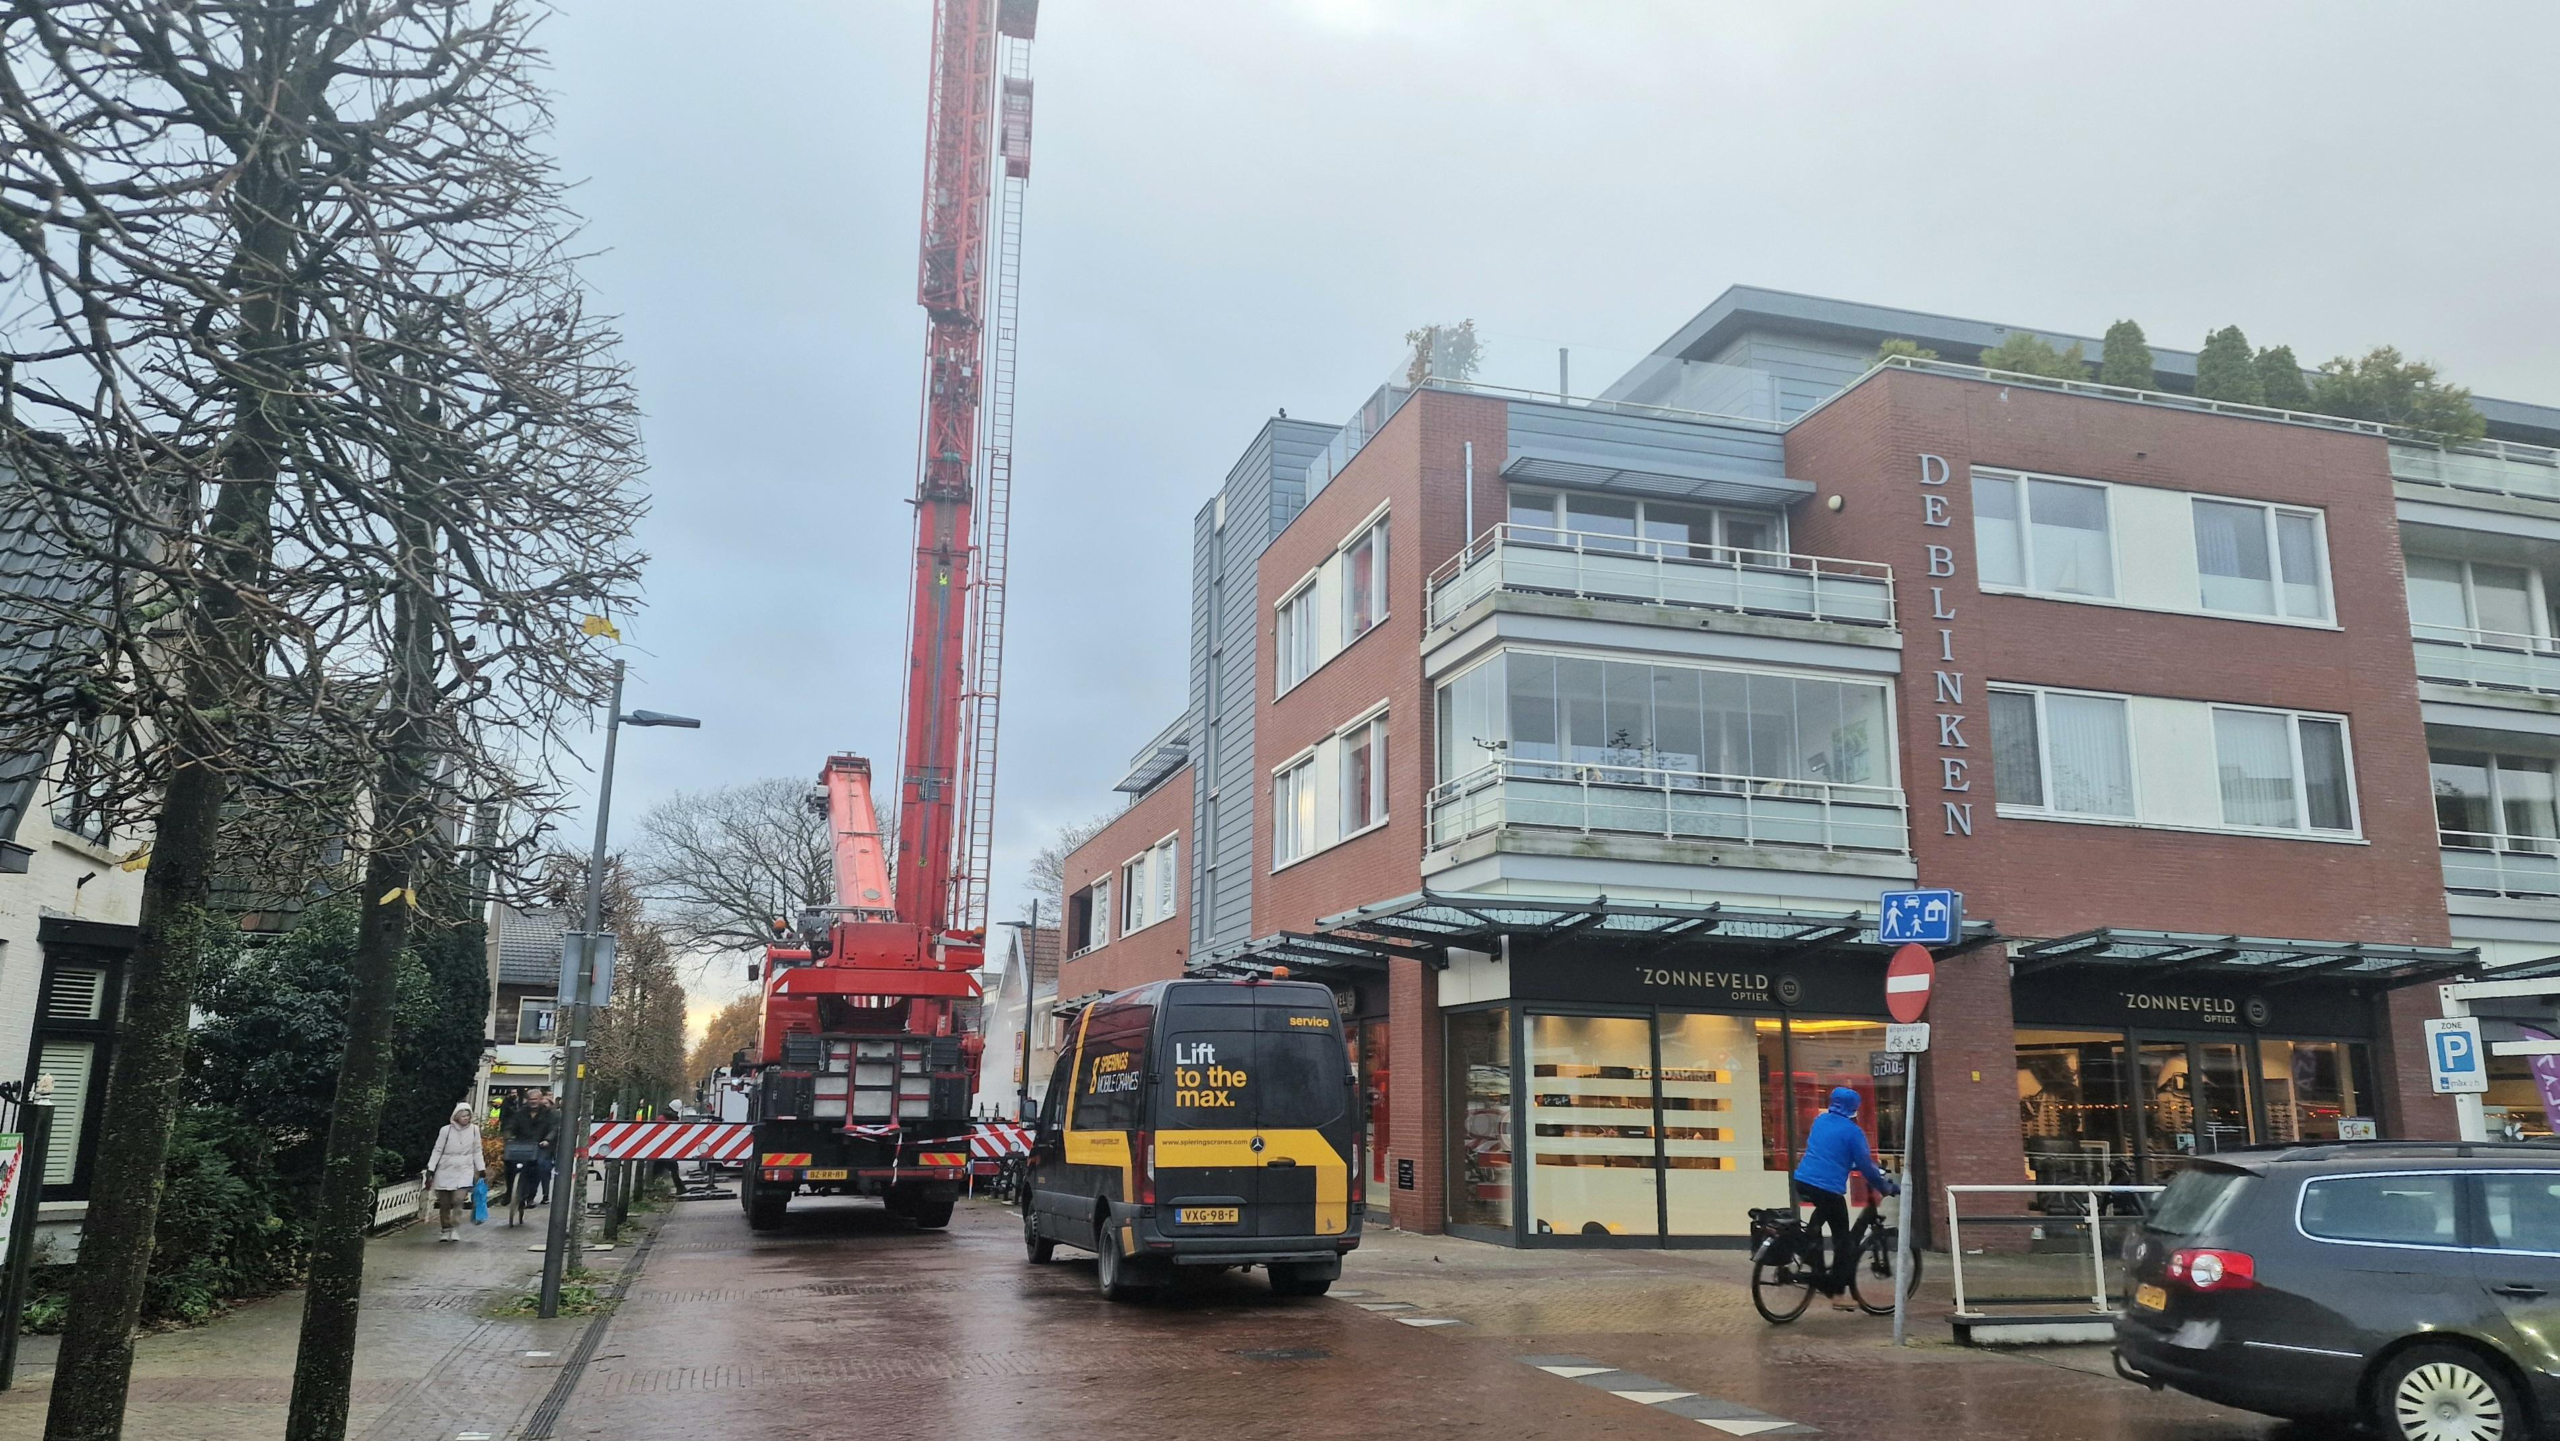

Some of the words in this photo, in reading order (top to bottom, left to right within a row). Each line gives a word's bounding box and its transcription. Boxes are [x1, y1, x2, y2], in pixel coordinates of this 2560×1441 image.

[1918, 453, 1952, 527] DE
[1925, 544, 1972, 836] BLINKEN
[1643, 969, 1768, 990] ZONNEVELD
[1731, 991, 1769, 1001] OPTIEK
[2126, 993, 2235, 1013] ZONNEVELD
[1289, 1016, 1329, 1027] service
[2203, 1014, 2237, 1024] OPTIEK
[2441, 1021, 2463, 1030] ZONE
[1099, 1051, 1130, 1073] SPIERINGS
[1175, 1043, 1216, 1065] Lift
[2443, 1035, 2468, 1069] P
[1175, 1066, 1201, 1088] to
[1207, 1065, 1248, 1088] the
[1175, 1090, 1236, 1107] max.
[1162, 1138, 1248, 1147] www.spieringscranes.com
[1185, 1210, 1235, 1221] VXG-98-F
